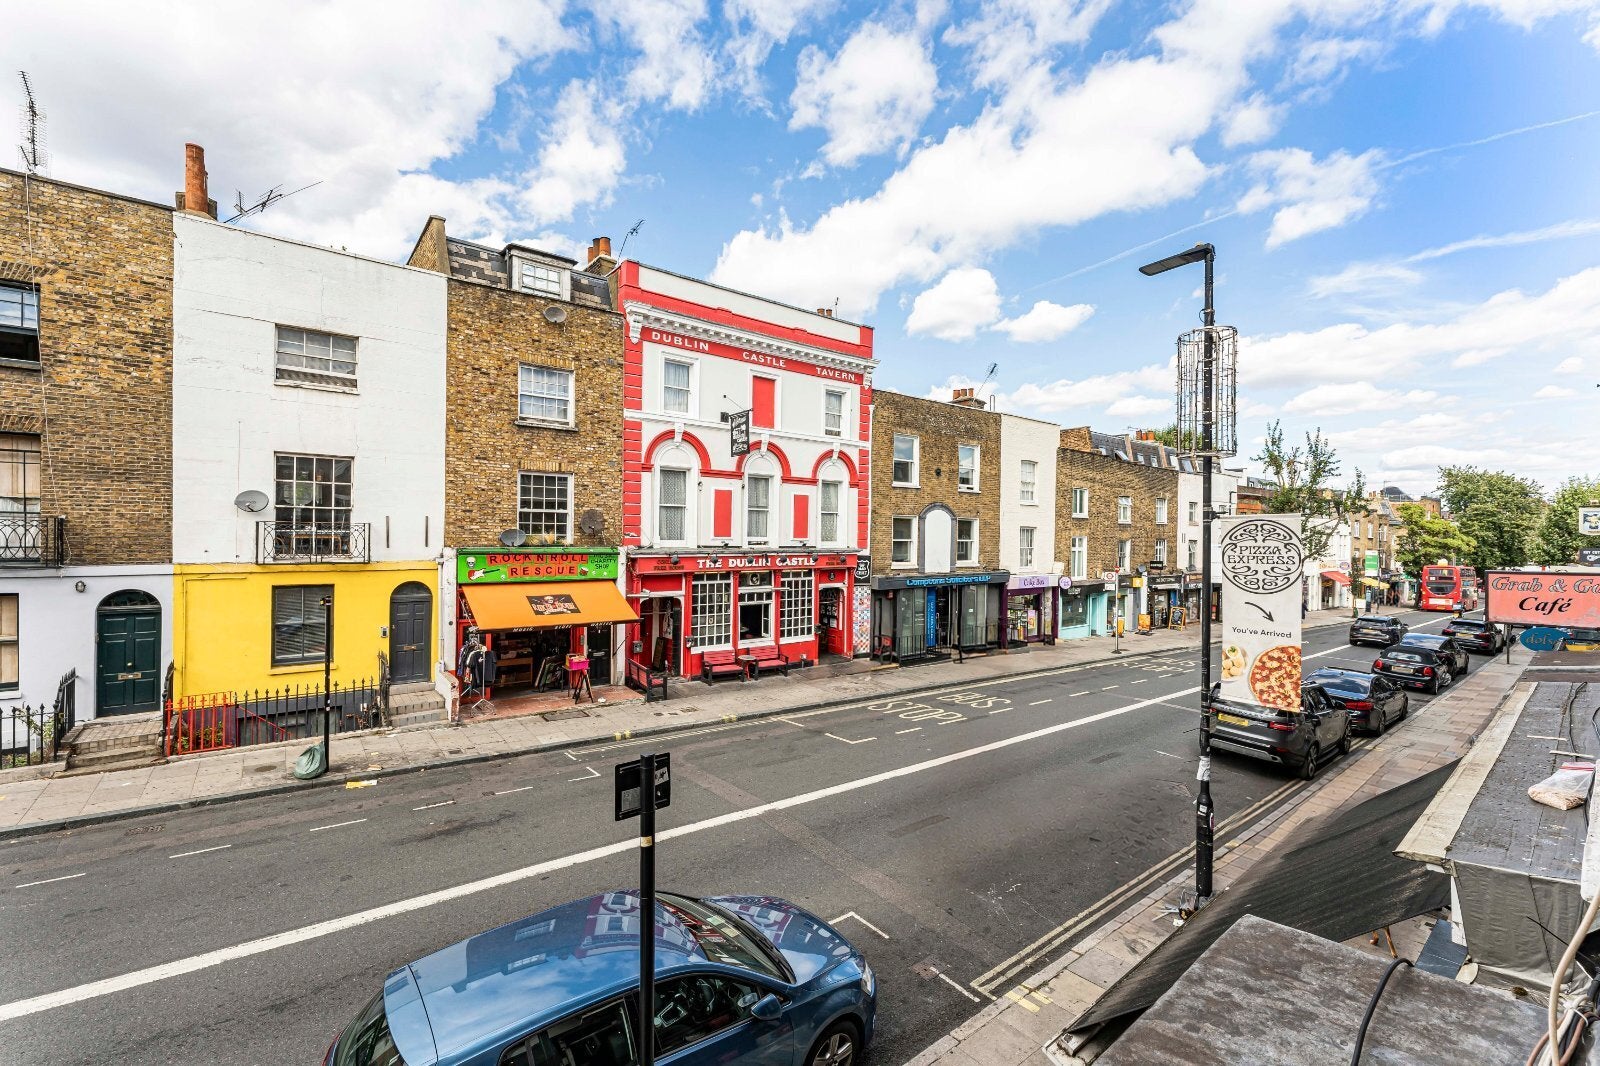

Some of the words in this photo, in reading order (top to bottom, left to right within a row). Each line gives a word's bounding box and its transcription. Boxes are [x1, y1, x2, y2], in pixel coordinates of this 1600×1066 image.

[652, 331, 709, 351] DUBLIN
[742, 351, 786, 367] CASTLE
[1239, 546, 1282, 555] PIZZA
[489, 554, 531, 565] ROCK
[551, 554, 587, 562] ROLL
[696, 558, 722, 569] THE
[1227, 555, 1296, 565] EXPRESS
[510, 565, 575, 576] RESCUE
[1491, 576, 1543, 593] Grab
[1548, 578, 1568, 593] &
[1518, 596, 1573, 615] Café
[1231, 626, 1259, 635] You've
[1260, 629, 1292, 638] Arrived
[936, 692, 1011, 708] BUS
[867, 701, 964, 721] STOP
